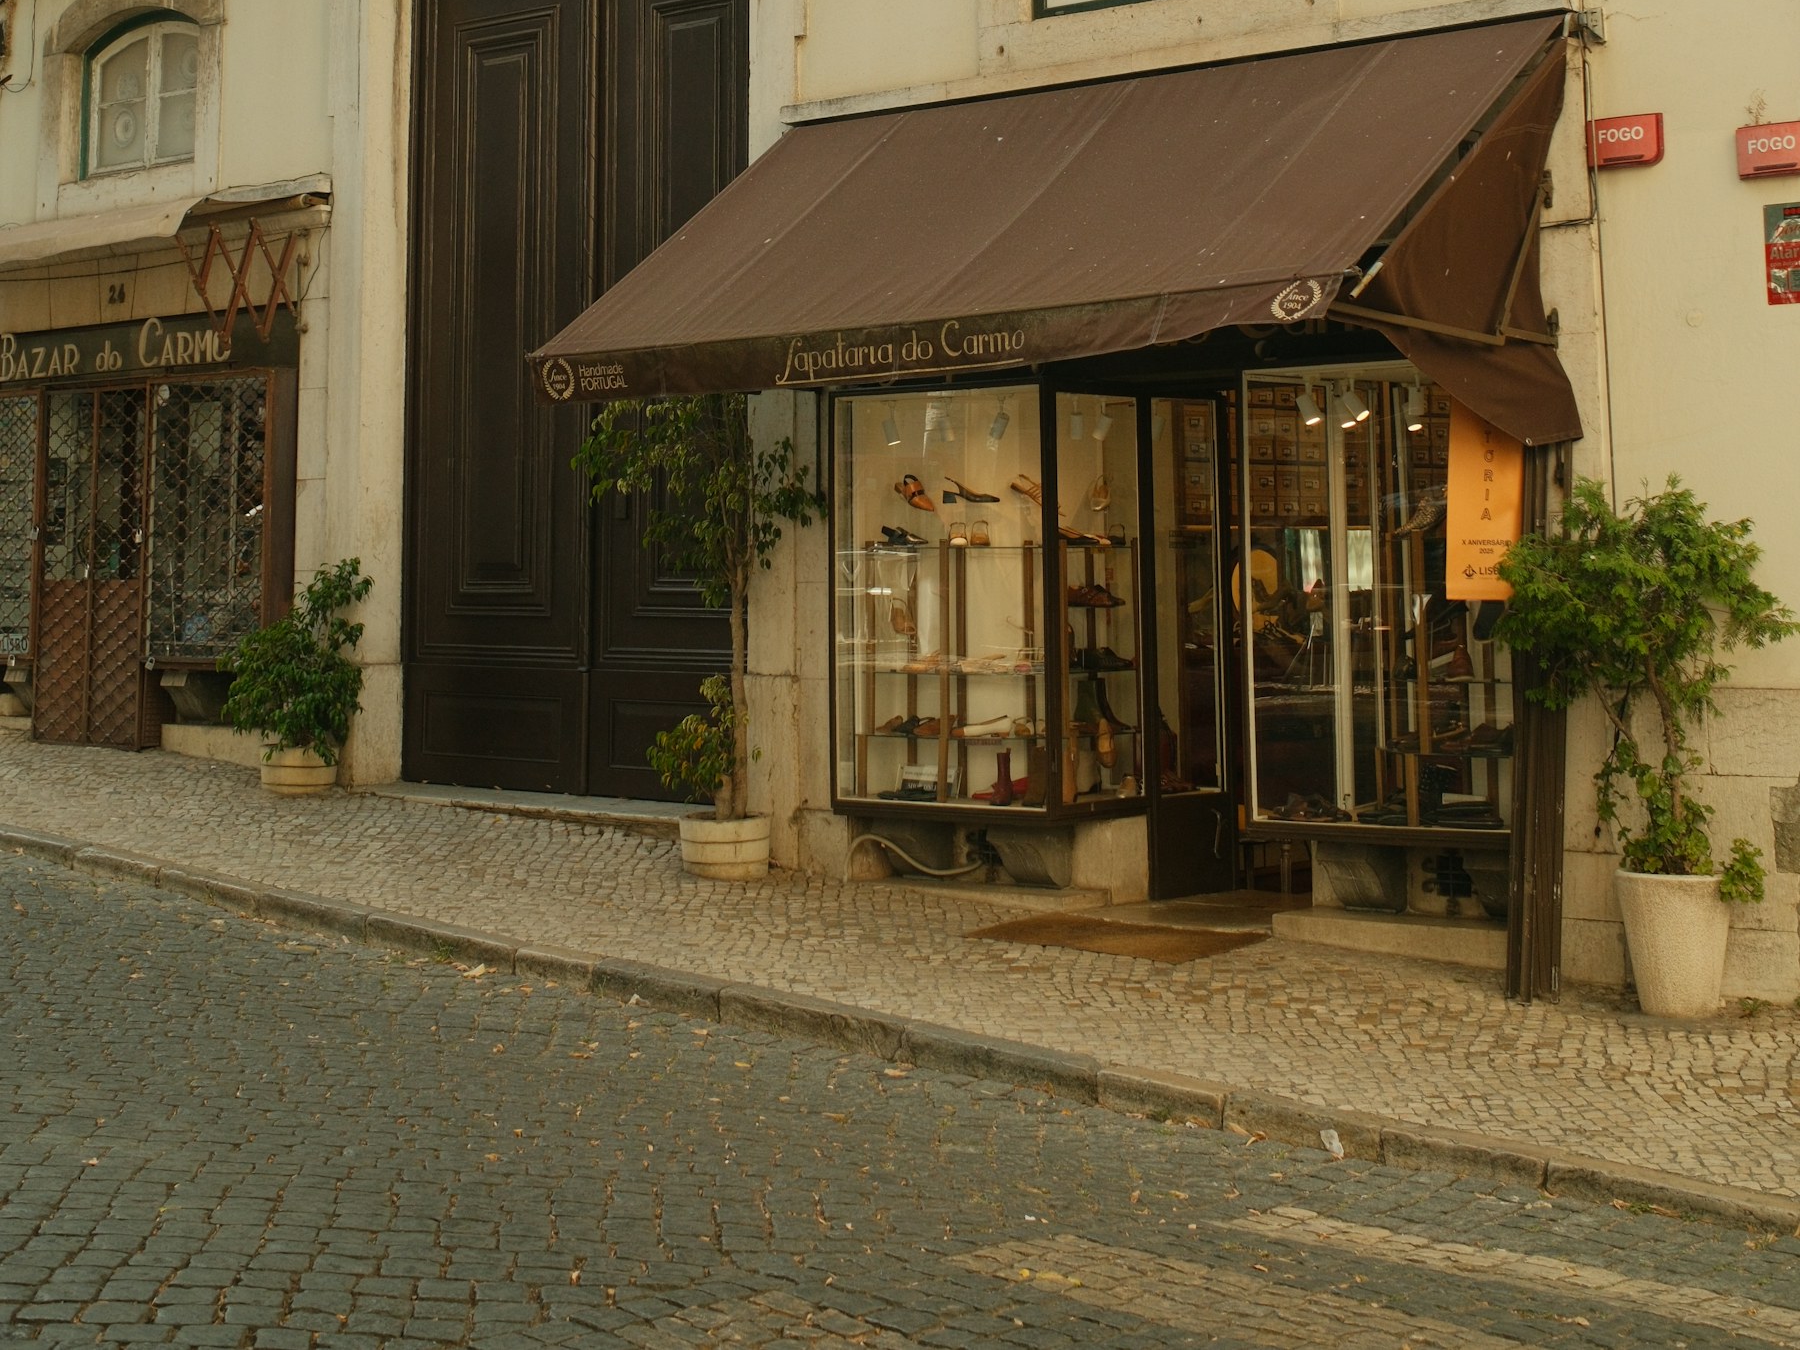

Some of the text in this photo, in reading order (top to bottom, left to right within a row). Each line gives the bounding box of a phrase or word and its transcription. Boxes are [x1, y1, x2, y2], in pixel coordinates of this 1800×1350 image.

[1598, 126, 1644, 144] FOGO
[1747, 135, 1797, 155] FOGO
[1282, 289, 1310, 302] Since
[1283, 301, 1302, 310] 1904
[0, 333, 80, 381] BAZAR
[95, 339, 123, 372] do
[775, 319, 1026, 385] Sapataria do Carmo
[549, 368, 568, 383] Since
[578, 362, 624, 377] Handmade
[552, 383, 566, 391] 1904
[580, 375, 629, 391] PORTUGAL
[1479, 566, 1499, 575] LISB
